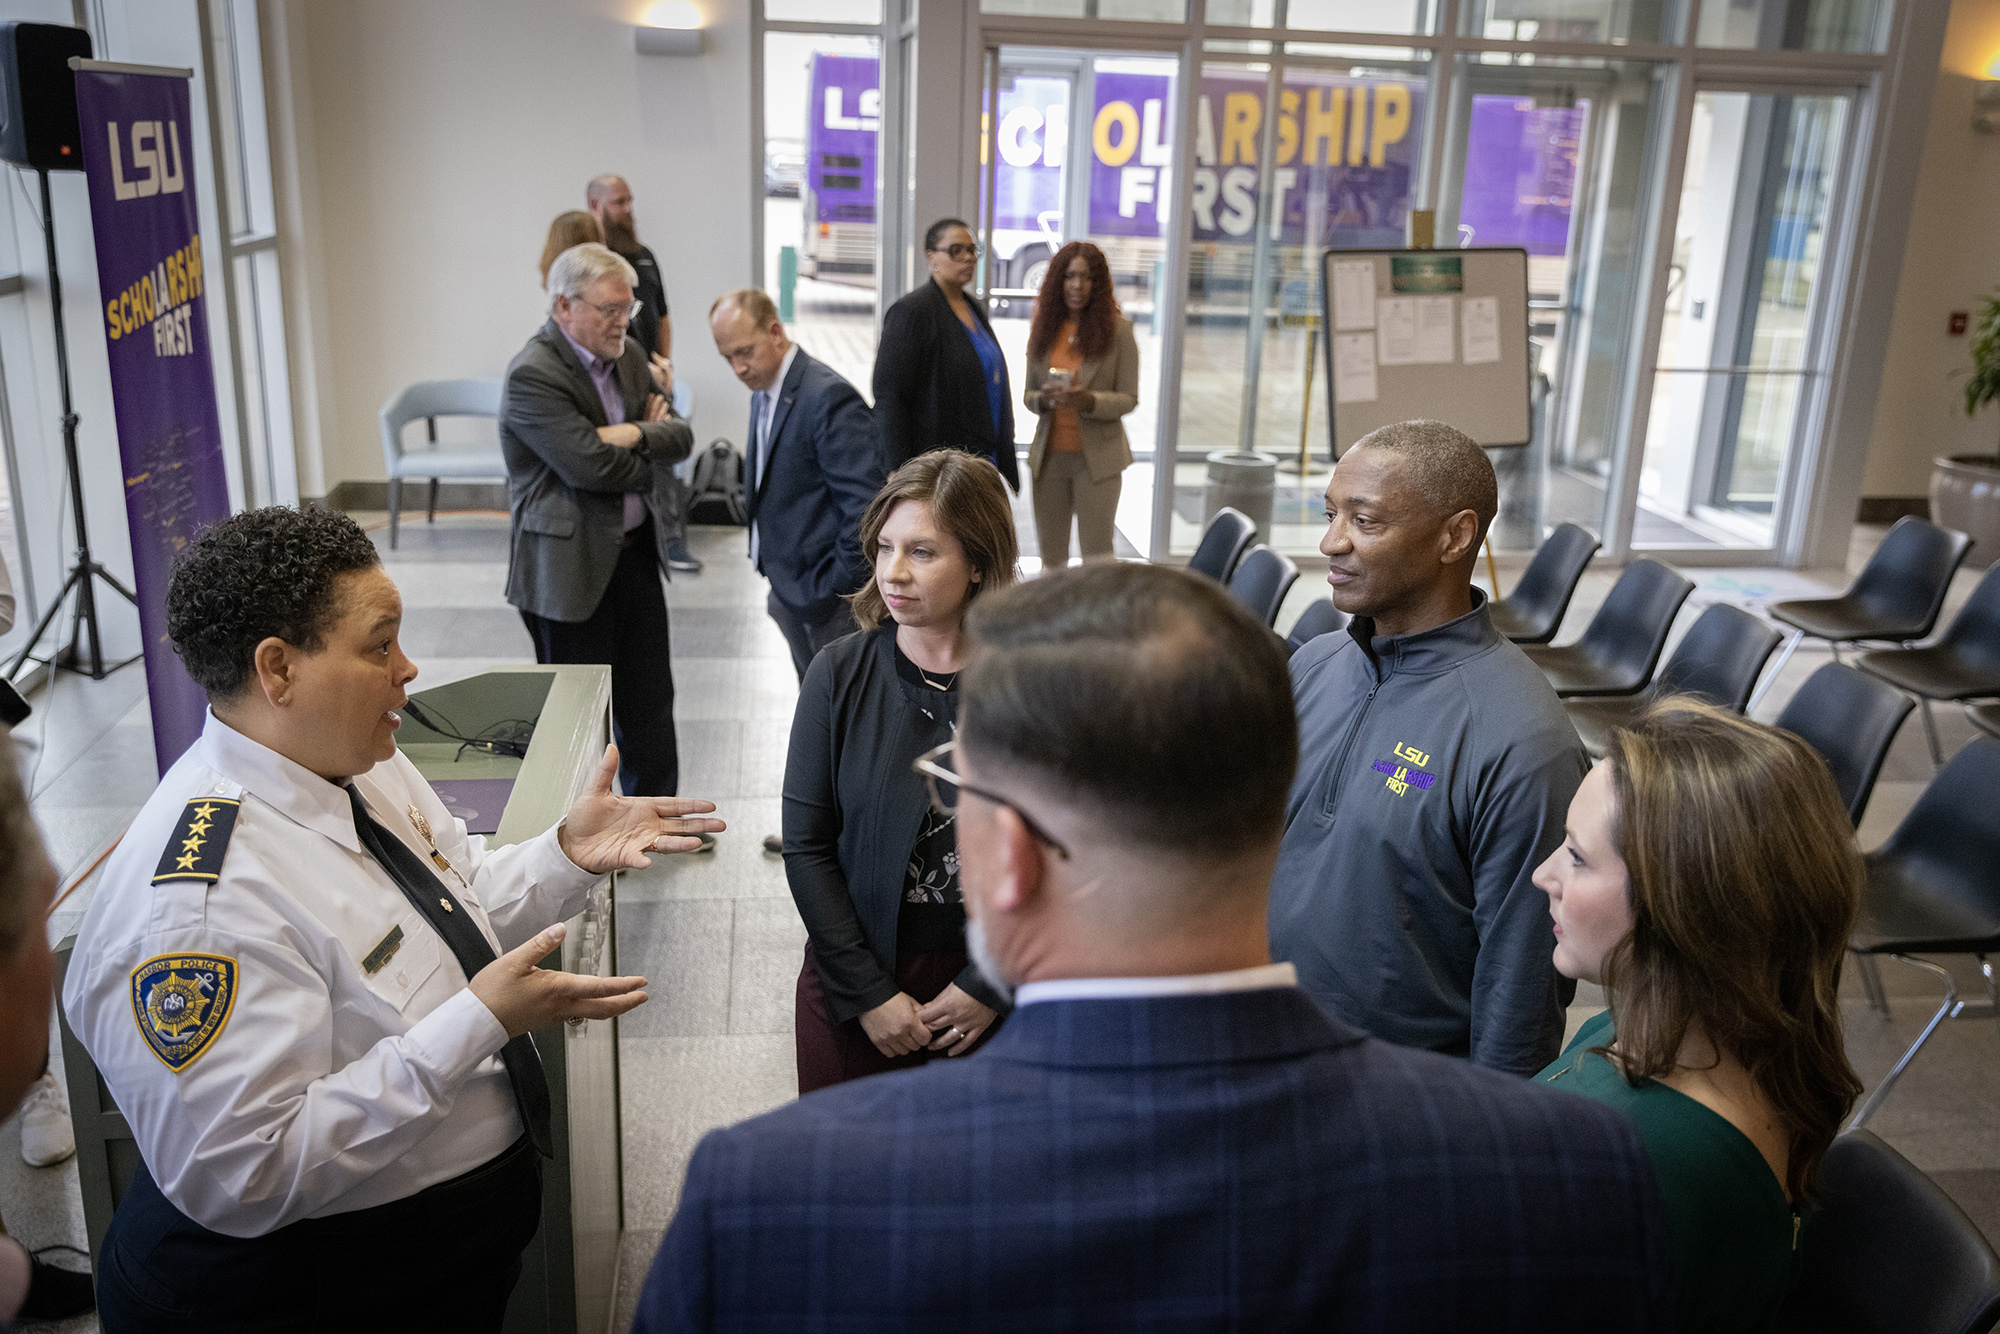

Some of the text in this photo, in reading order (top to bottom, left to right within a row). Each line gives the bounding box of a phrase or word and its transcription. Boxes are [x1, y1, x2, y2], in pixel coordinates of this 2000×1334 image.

[107, 121, 184, 201] LSU
[1118, 166, 1296, 240] FIRST
[153, 303, 194, 357] FIRST
[1393, 741, 1430, 768] LSU
[1372, 760, 1436, 790] SCHOLARSHIP
[1385, 776, 1409, 798] FIRST
[139, 959, 219, 980] HARBOR POLICE
